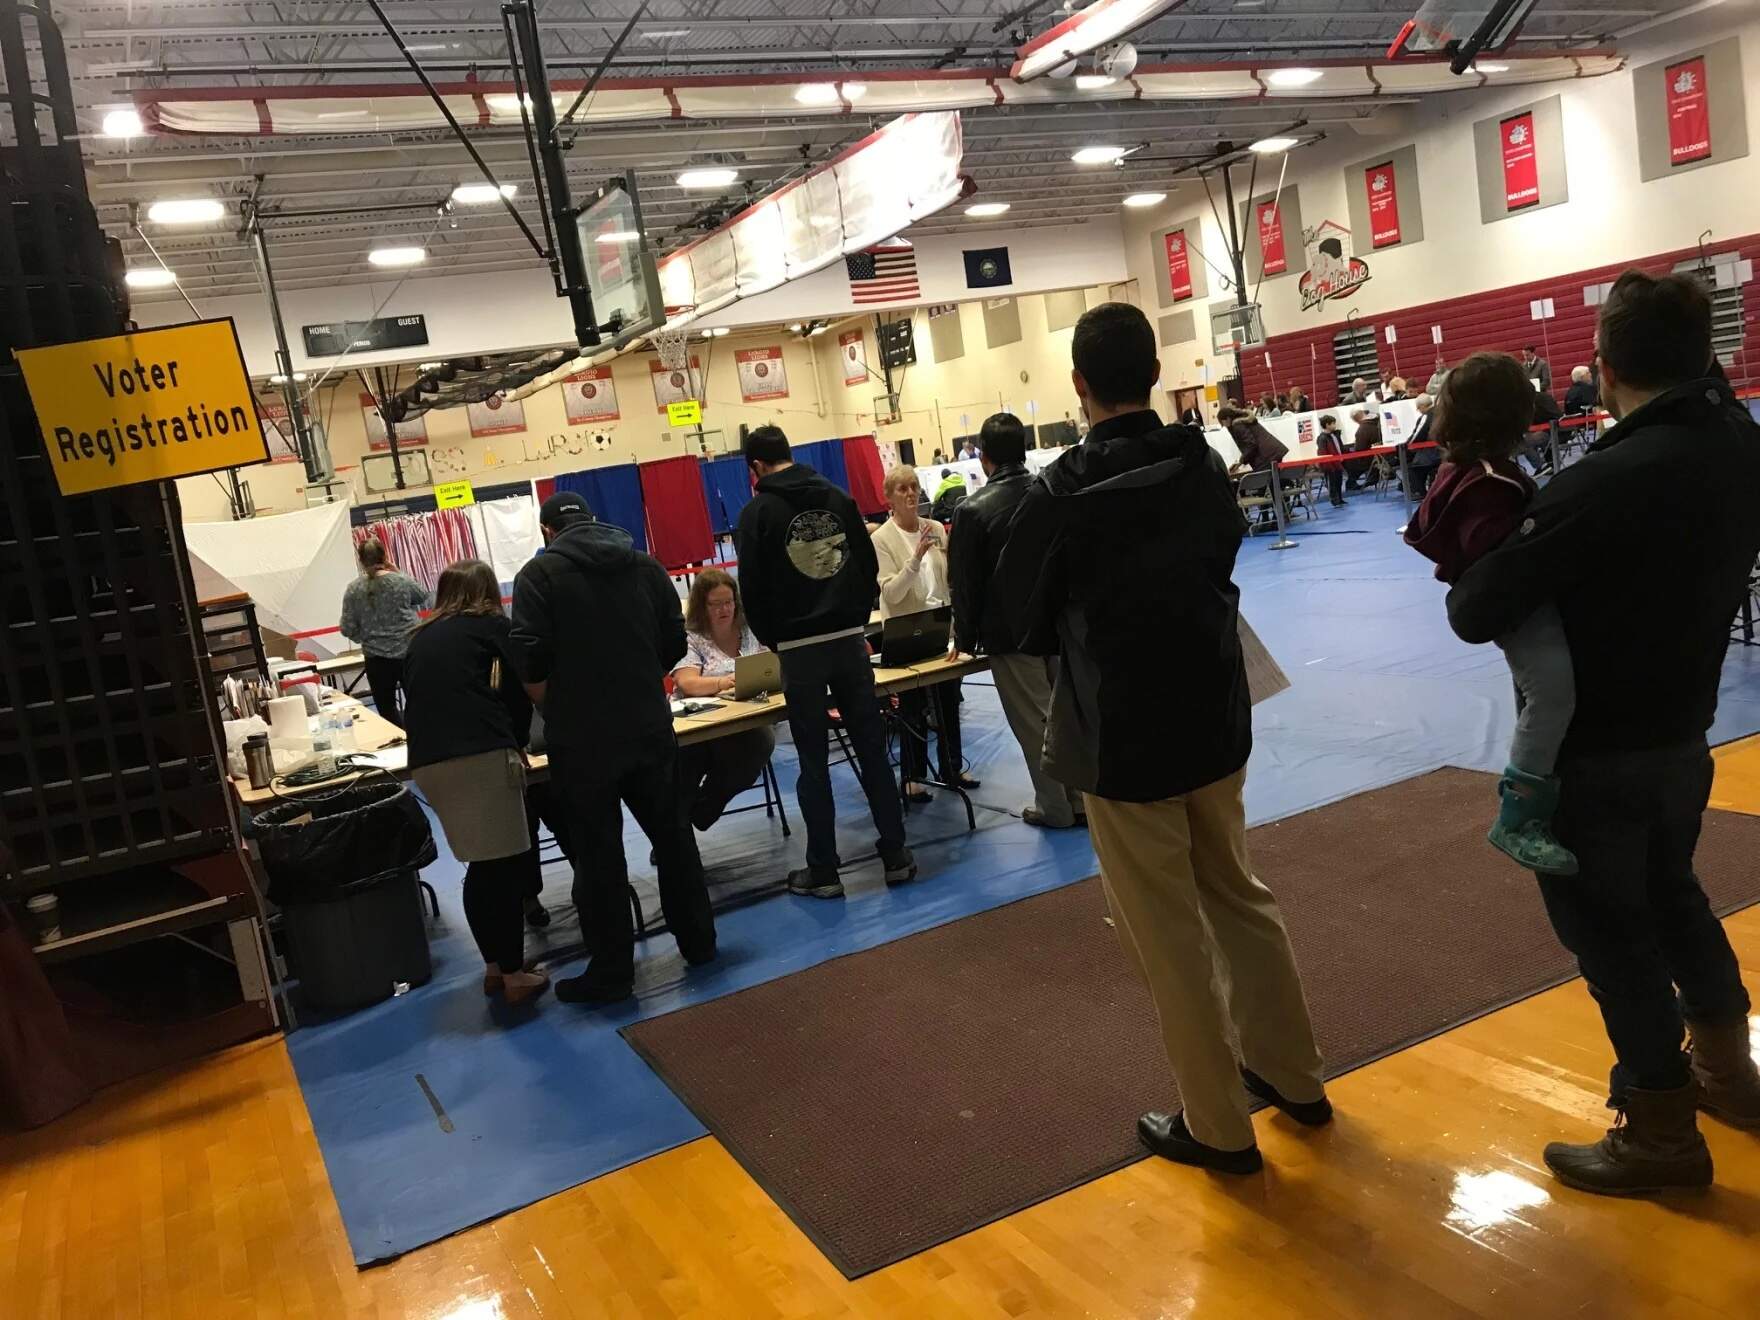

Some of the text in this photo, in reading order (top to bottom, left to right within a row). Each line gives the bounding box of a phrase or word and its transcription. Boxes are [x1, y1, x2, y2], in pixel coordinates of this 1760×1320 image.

[1673, 141, 1708, 156] BULLDOGS
[1325, 264, 1367, 295] House
[397, 316, 420, 326] GUEST
[308, 326, 331, 335] HOME
[93, 358, 178, 398] Voter
[54, 403, 249, 466] Registration
[452, 484, 466, 492] Here
